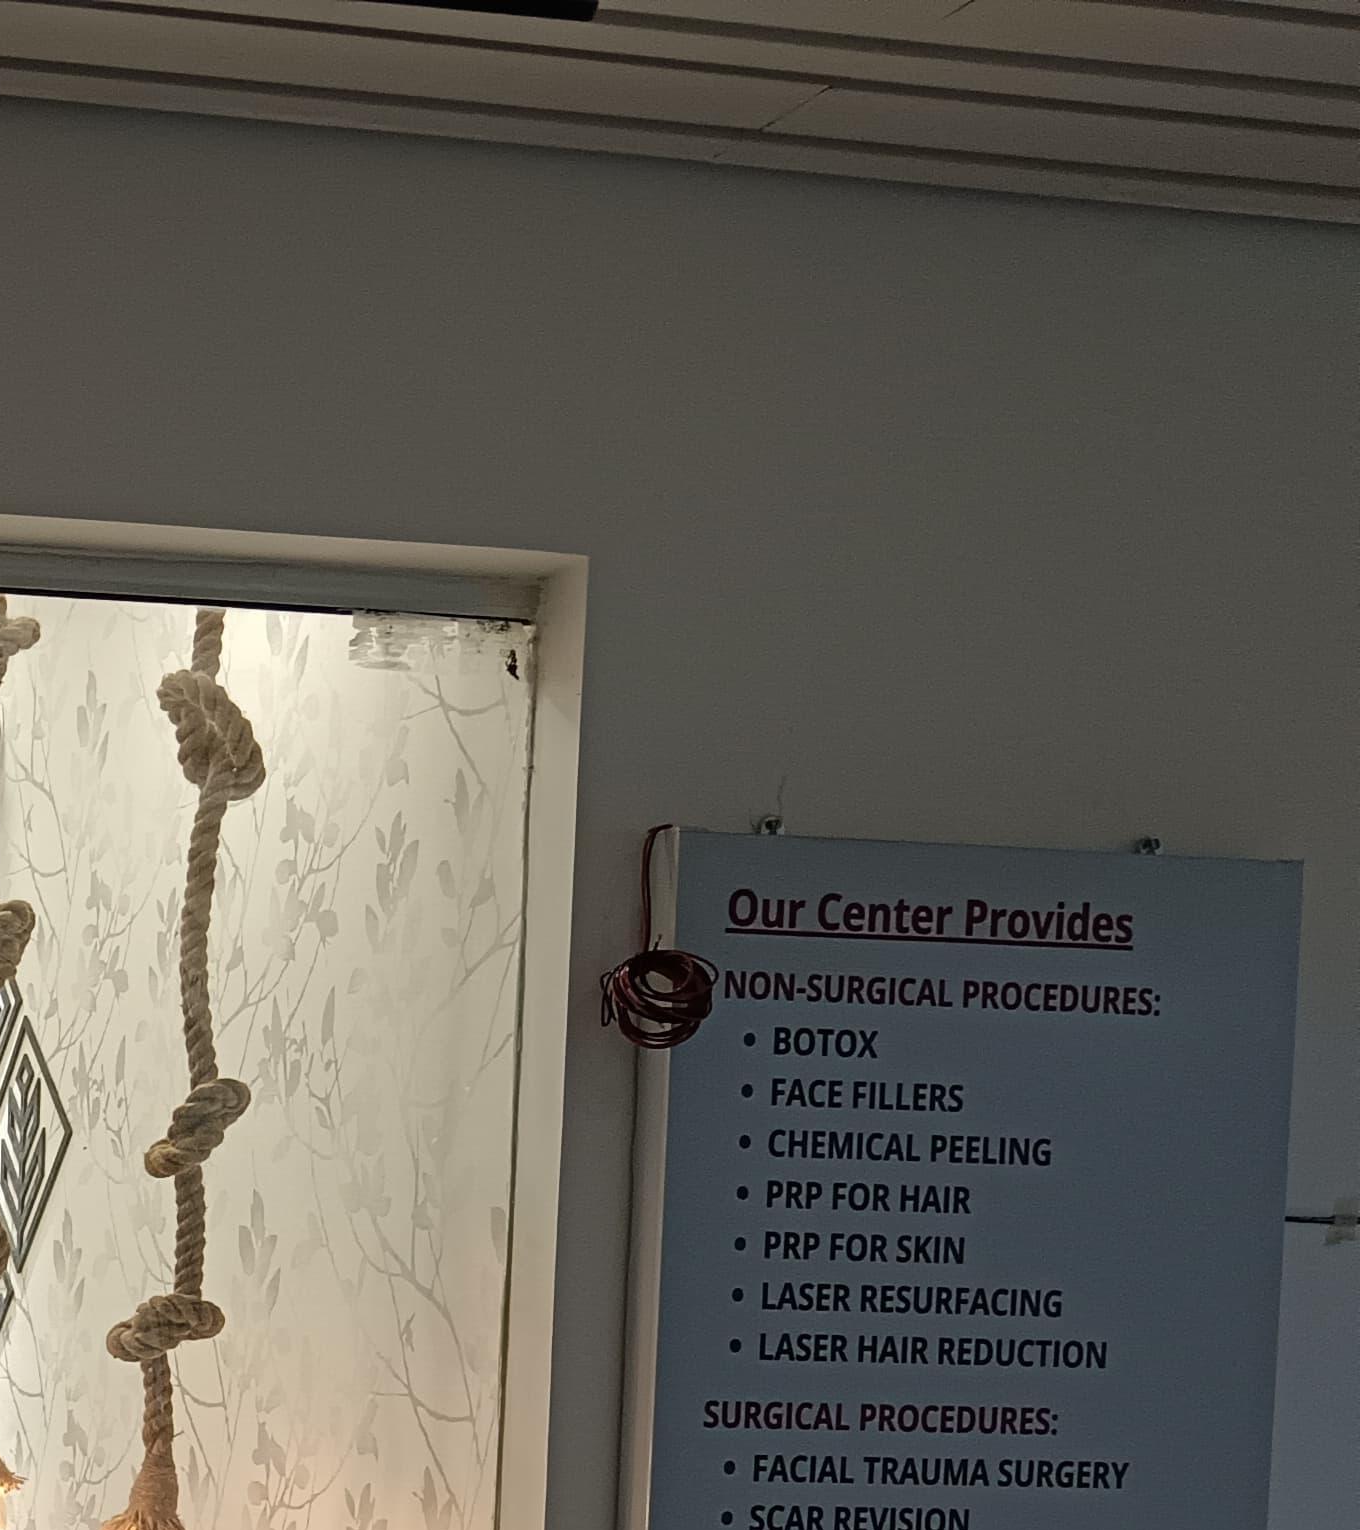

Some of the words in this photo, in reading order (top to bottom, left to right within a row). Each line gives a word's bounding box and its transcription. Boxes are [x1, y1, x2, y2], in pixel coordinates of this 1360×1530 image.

[728, 890, 804, 930] Our
[818, 893, 953, 936] Center
[965, 900, 1133, 944] Provides
[725, 971, 952, 1007] NON-SURGICAL
[963, 981, 1160, 1016] PROCEDURES:
[774, 1027, 878, 1058] BOTOX
[772, 1079, 843, 1108] FACE
[853, 1082, 963, 1112] FILLERS
[769, 1129, 920, 1161] CHEMICAL
[931, 1135, 1051, 1166] PEELING
[767, 1181, 822, 1209] PRP
[833, 1183, 890, 1211] FOR
[900, 1185, 970, 1214] HAIR
[765, 1232, 820, 1259] PRP
[830, 1233, 887, 1262] FOR
[896, 1235, 964, 1264] SKIN
[762, 1283, 850, 1311] LASER
[861, 1285, 1062, 1317] RESURFACING
[760, 1333, 847, 1362] LASER
[858, 1336, 928, 1364] HAIR
[939, 1338, 1106, 1368] REDUCTION
[704, 1401, 849, 1430] SURGICAL
[860, 1404, 1058, 1435] PROCEDURES:
[754, 1455, 854, 1483] FACIAL
[864, 1457, 989, 1486] TRAUMA
[998, 1460, 1129, 1488] SURGERY
